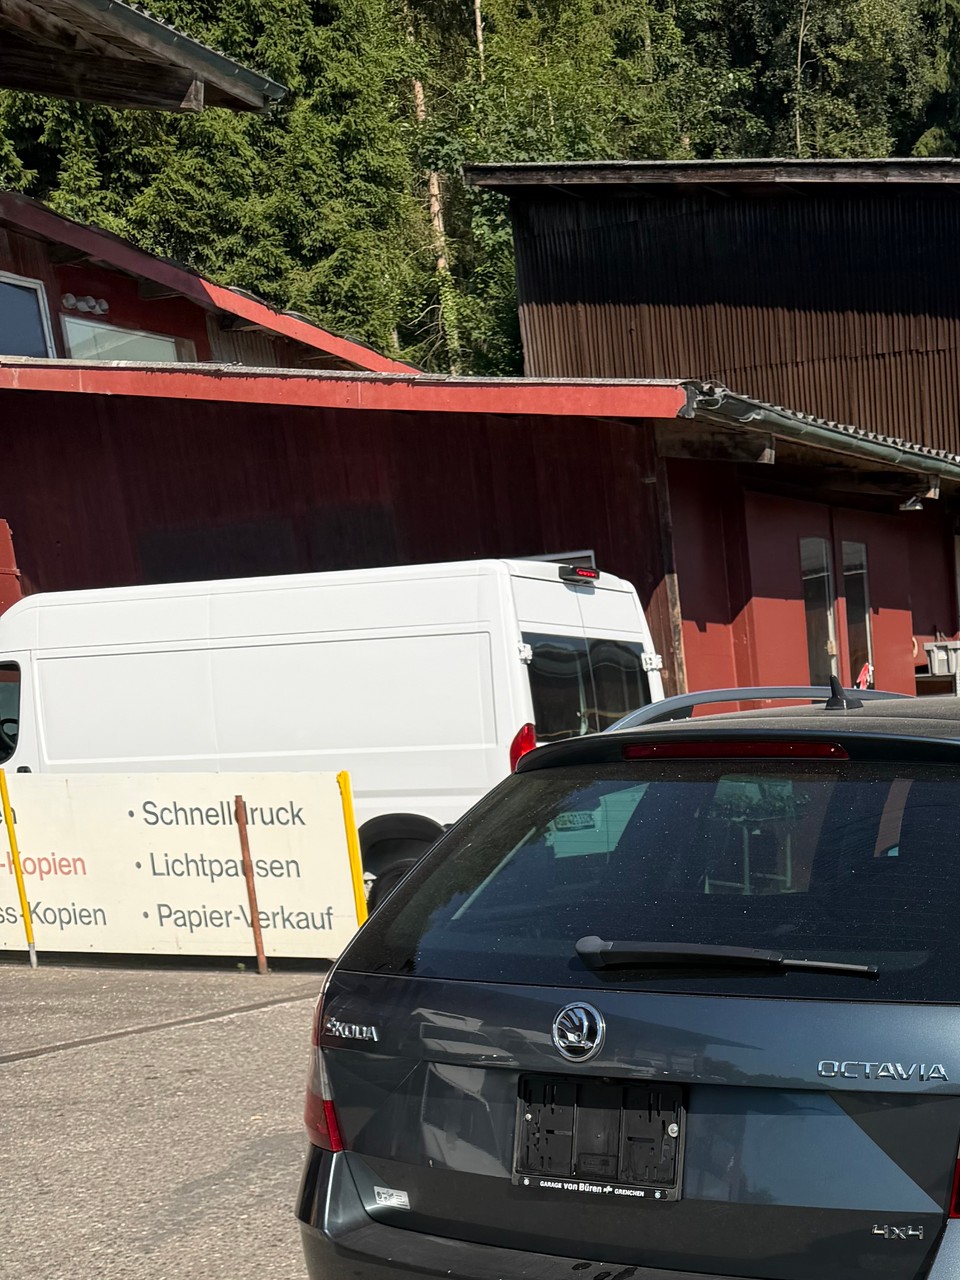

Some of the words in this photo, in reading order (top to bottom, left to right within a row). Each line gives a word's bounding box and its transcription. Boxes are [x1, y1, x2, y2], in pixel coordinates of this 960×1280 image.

[817, 1060, 949, 1082] OCTAVIA
[540, 1180, 562, 1189] GARAGE
[563, 1183, 578, 1191] von
[579, 1183, 602, 1193] Büren
[614, 1188, 645, 1197] GRENCHEN
[871, 1224, 924, 1240] 4x4
